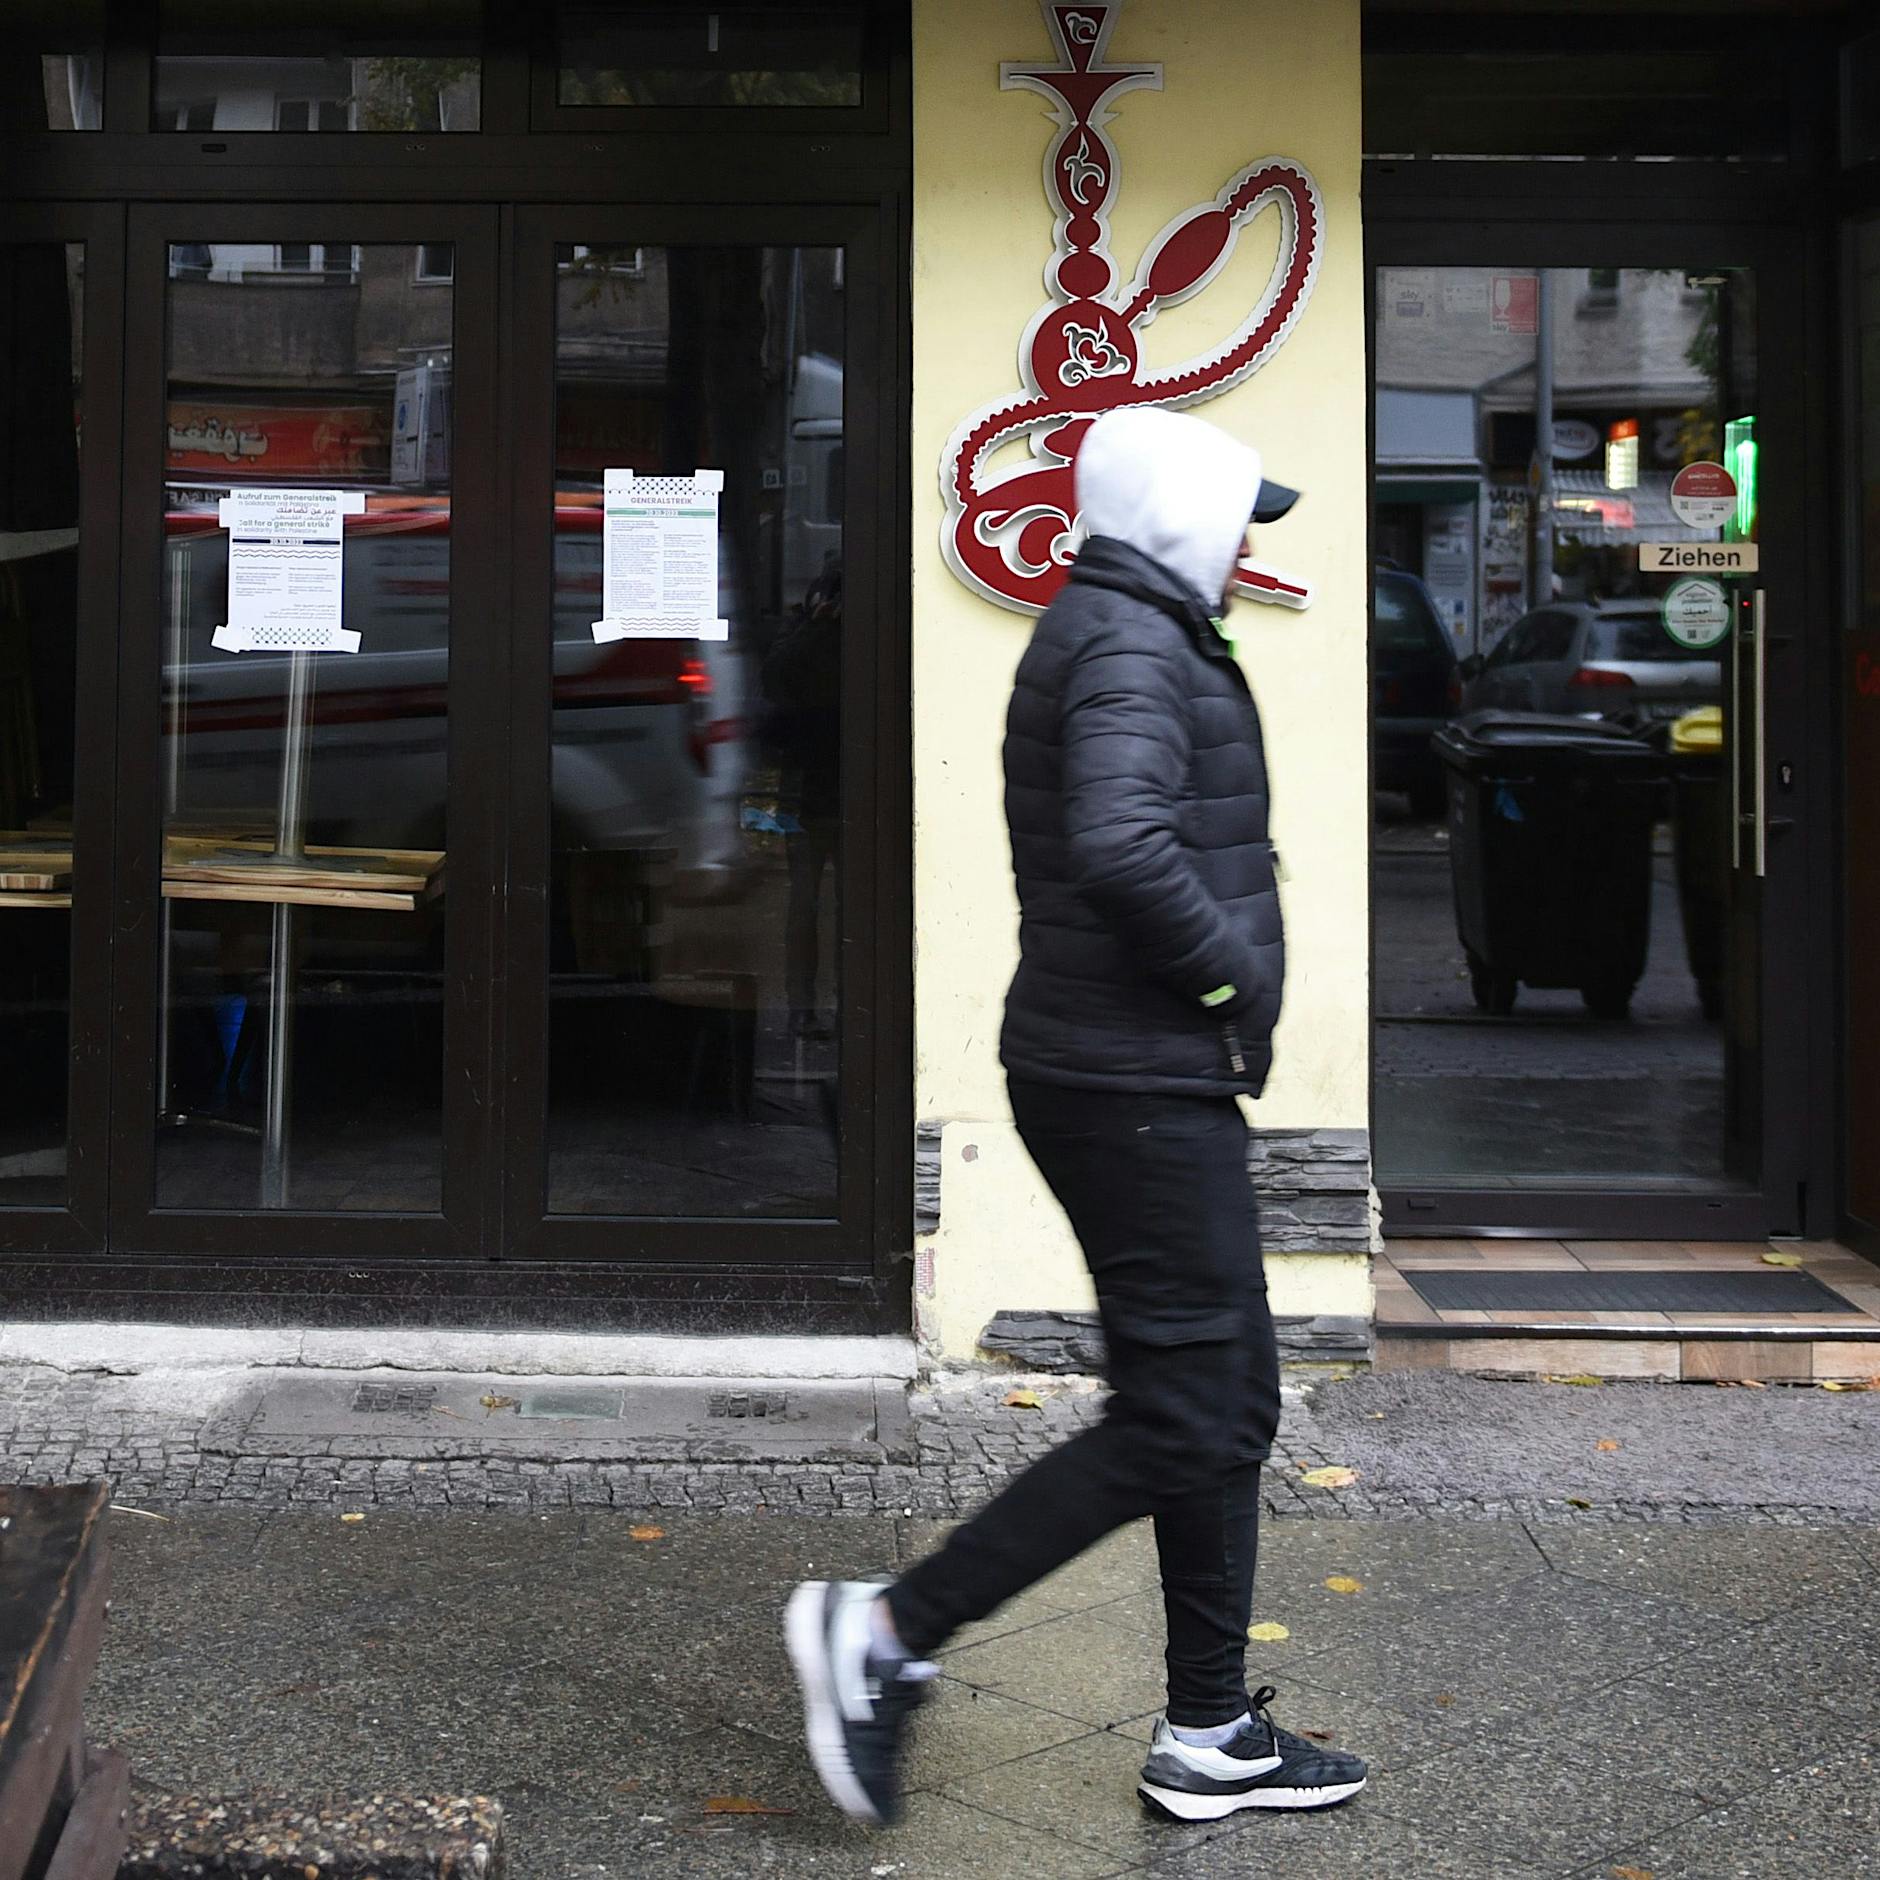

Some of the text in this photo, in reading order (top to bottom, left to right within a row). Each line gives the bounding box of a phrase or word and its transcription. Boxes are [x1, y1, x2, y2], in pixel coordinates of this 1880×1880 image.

[237, 492, 262, 500] Aufruf
[283, 494, 336, 502] Generalstreik
[630, 497, 692, 505] GENERALSTREIK
[274, 520, 305, 528] general
[1658, 547, 1741, 567] Ziehen
